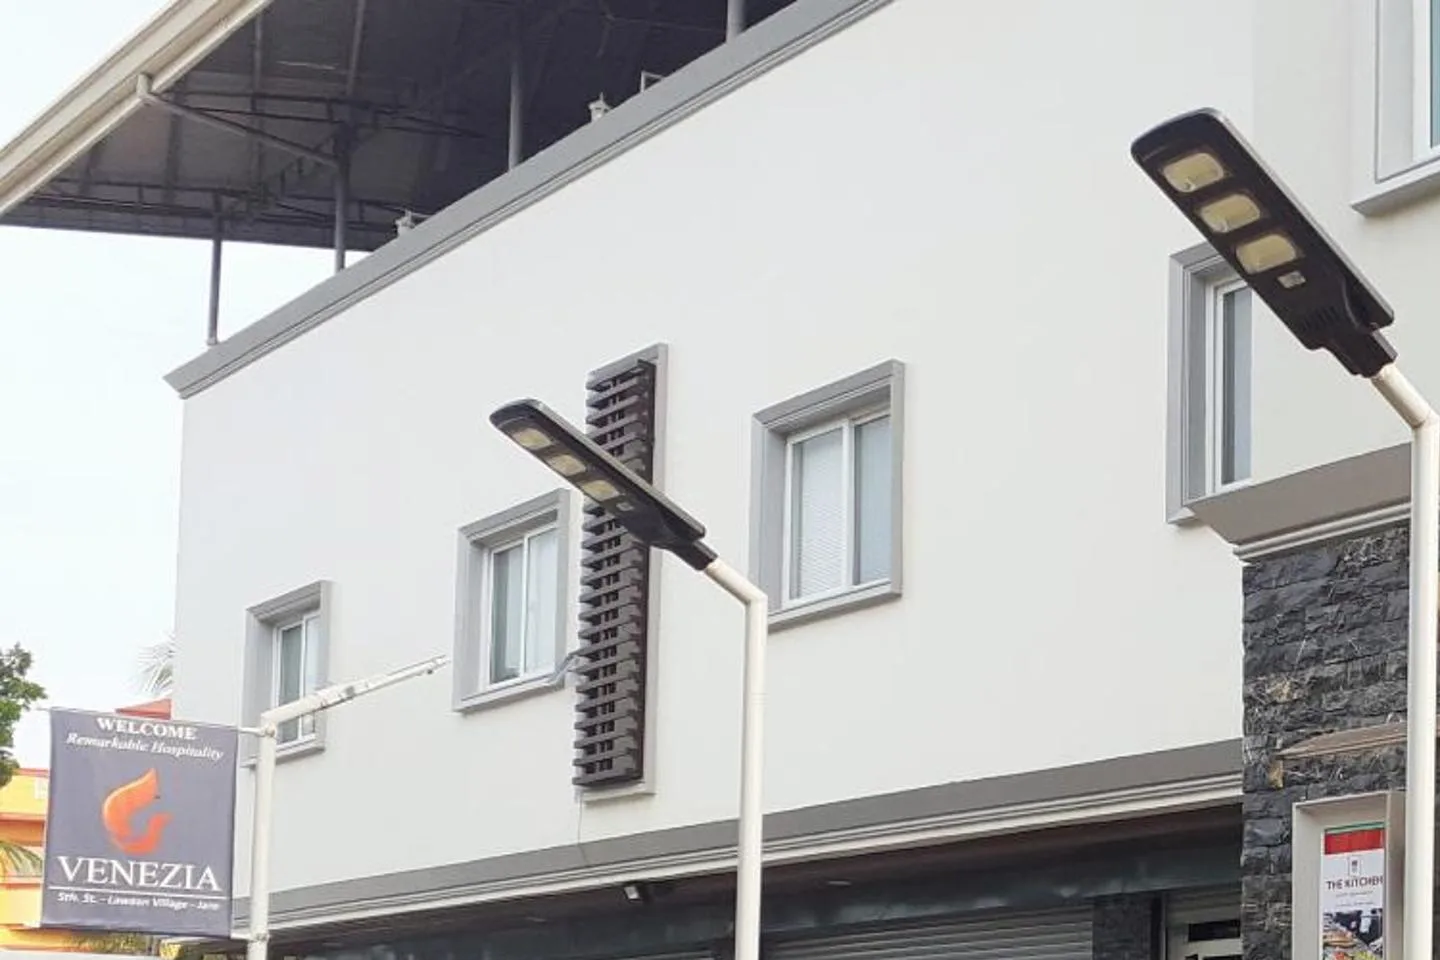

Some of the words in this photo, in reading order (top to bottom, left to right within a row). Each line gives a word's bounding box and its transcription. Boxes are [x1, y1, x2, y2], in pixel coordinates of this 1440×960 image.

[97, 717, 199, 740] WELCOME
[66, 732, 148, 752] Remarkable
[151, 741, 224, 761] Hospitality
[57, 856, 222, 892] VENEZIA
